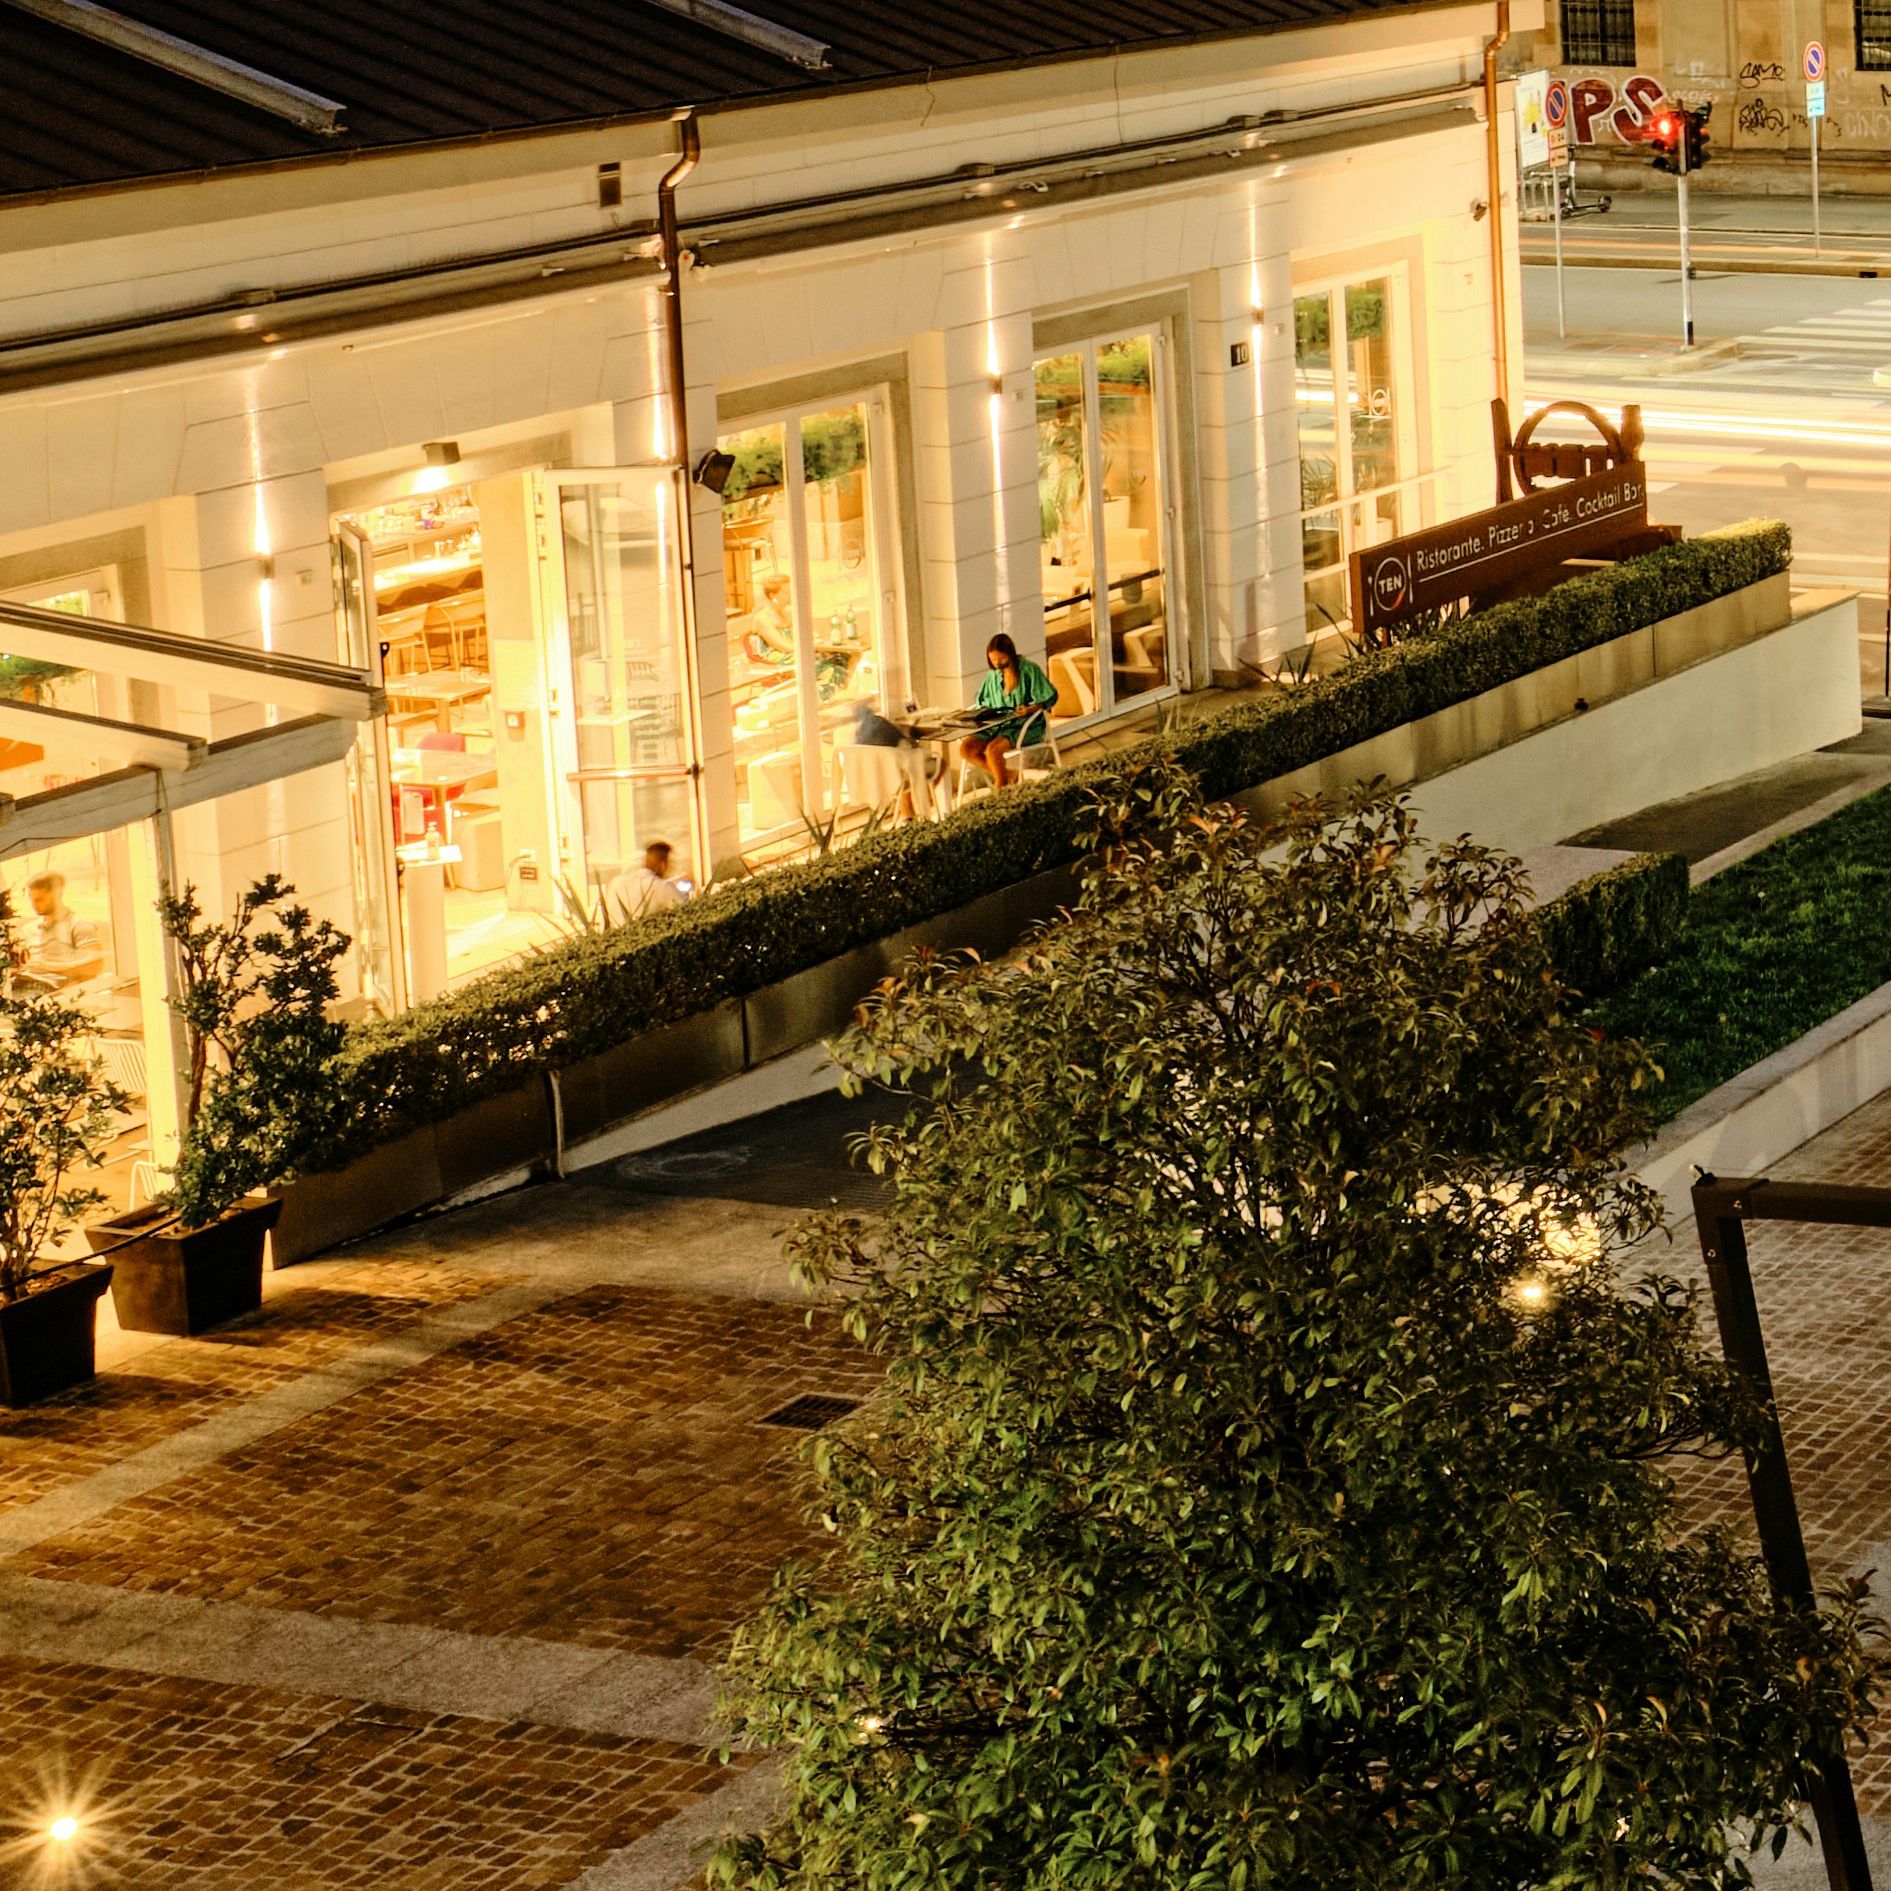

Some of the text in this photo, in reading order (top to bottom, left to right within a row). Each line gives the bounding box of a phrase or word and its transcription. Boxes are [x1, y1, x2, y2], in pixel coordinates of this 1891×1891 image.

[1236, 345, 1248, 363] 10
[1576, 484, 1621, 518] Cocktail
[1379, 574, 1401, 595] TEN
